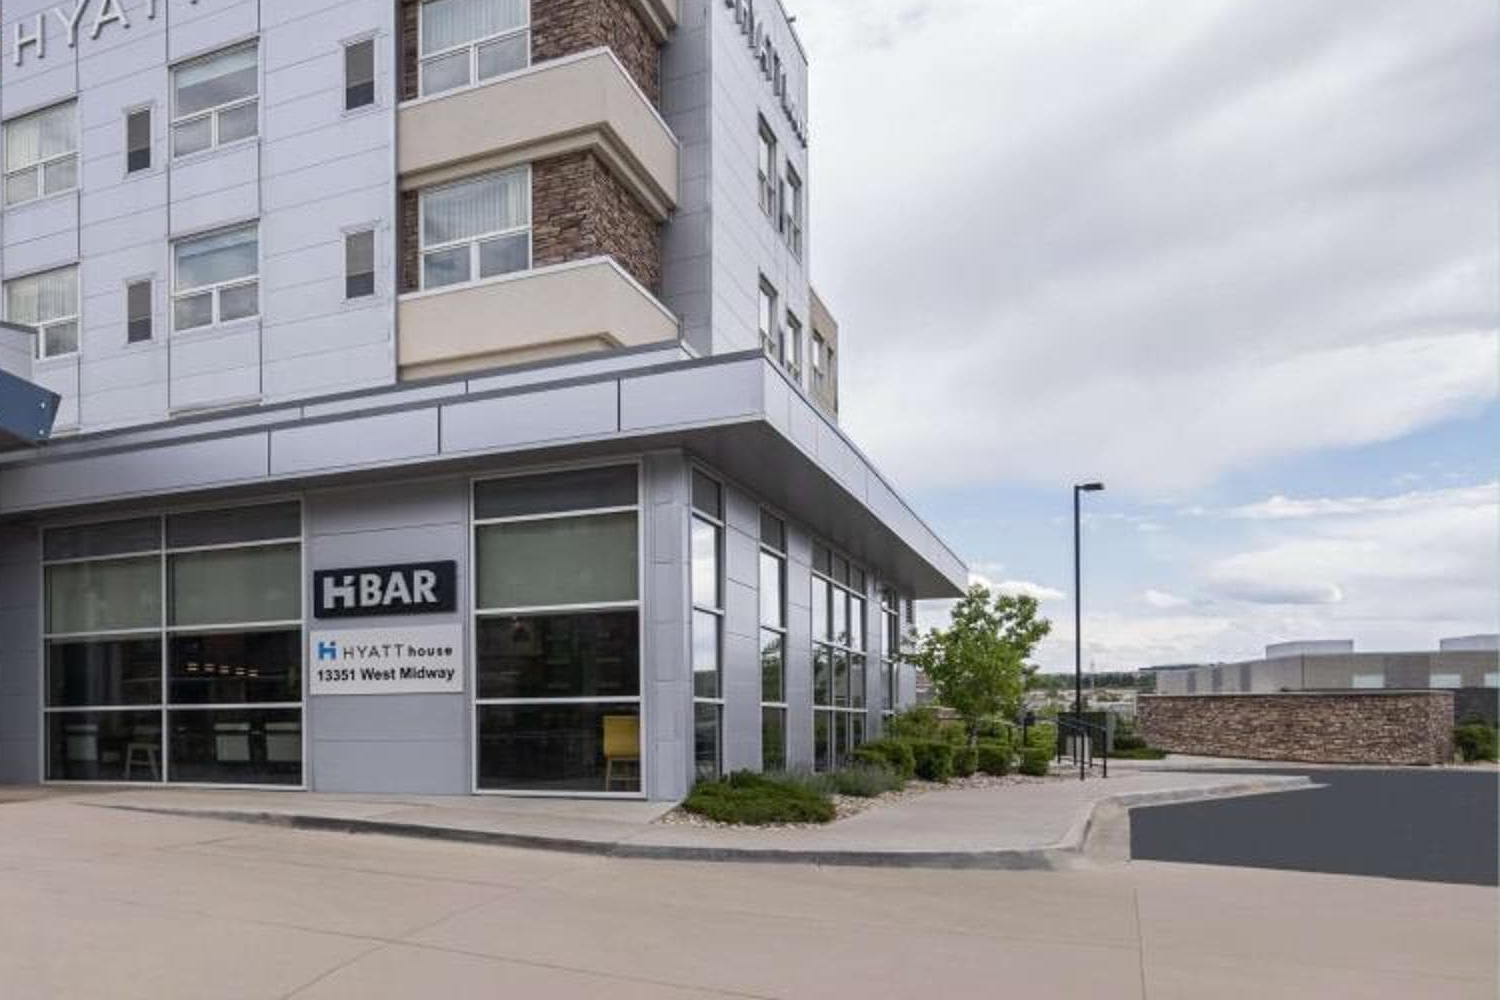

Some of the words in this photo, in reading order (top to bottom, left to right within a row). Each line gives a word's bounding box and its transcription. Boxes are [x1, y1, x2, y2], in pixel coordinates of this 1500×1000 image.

[343, 643, 404, 660] HYATT
[407, 645, 453, 657] house
[317, 669, 355, 681] 13351
[360, 667, 396, 681] West
[400, 666, 455, 682] Midway
